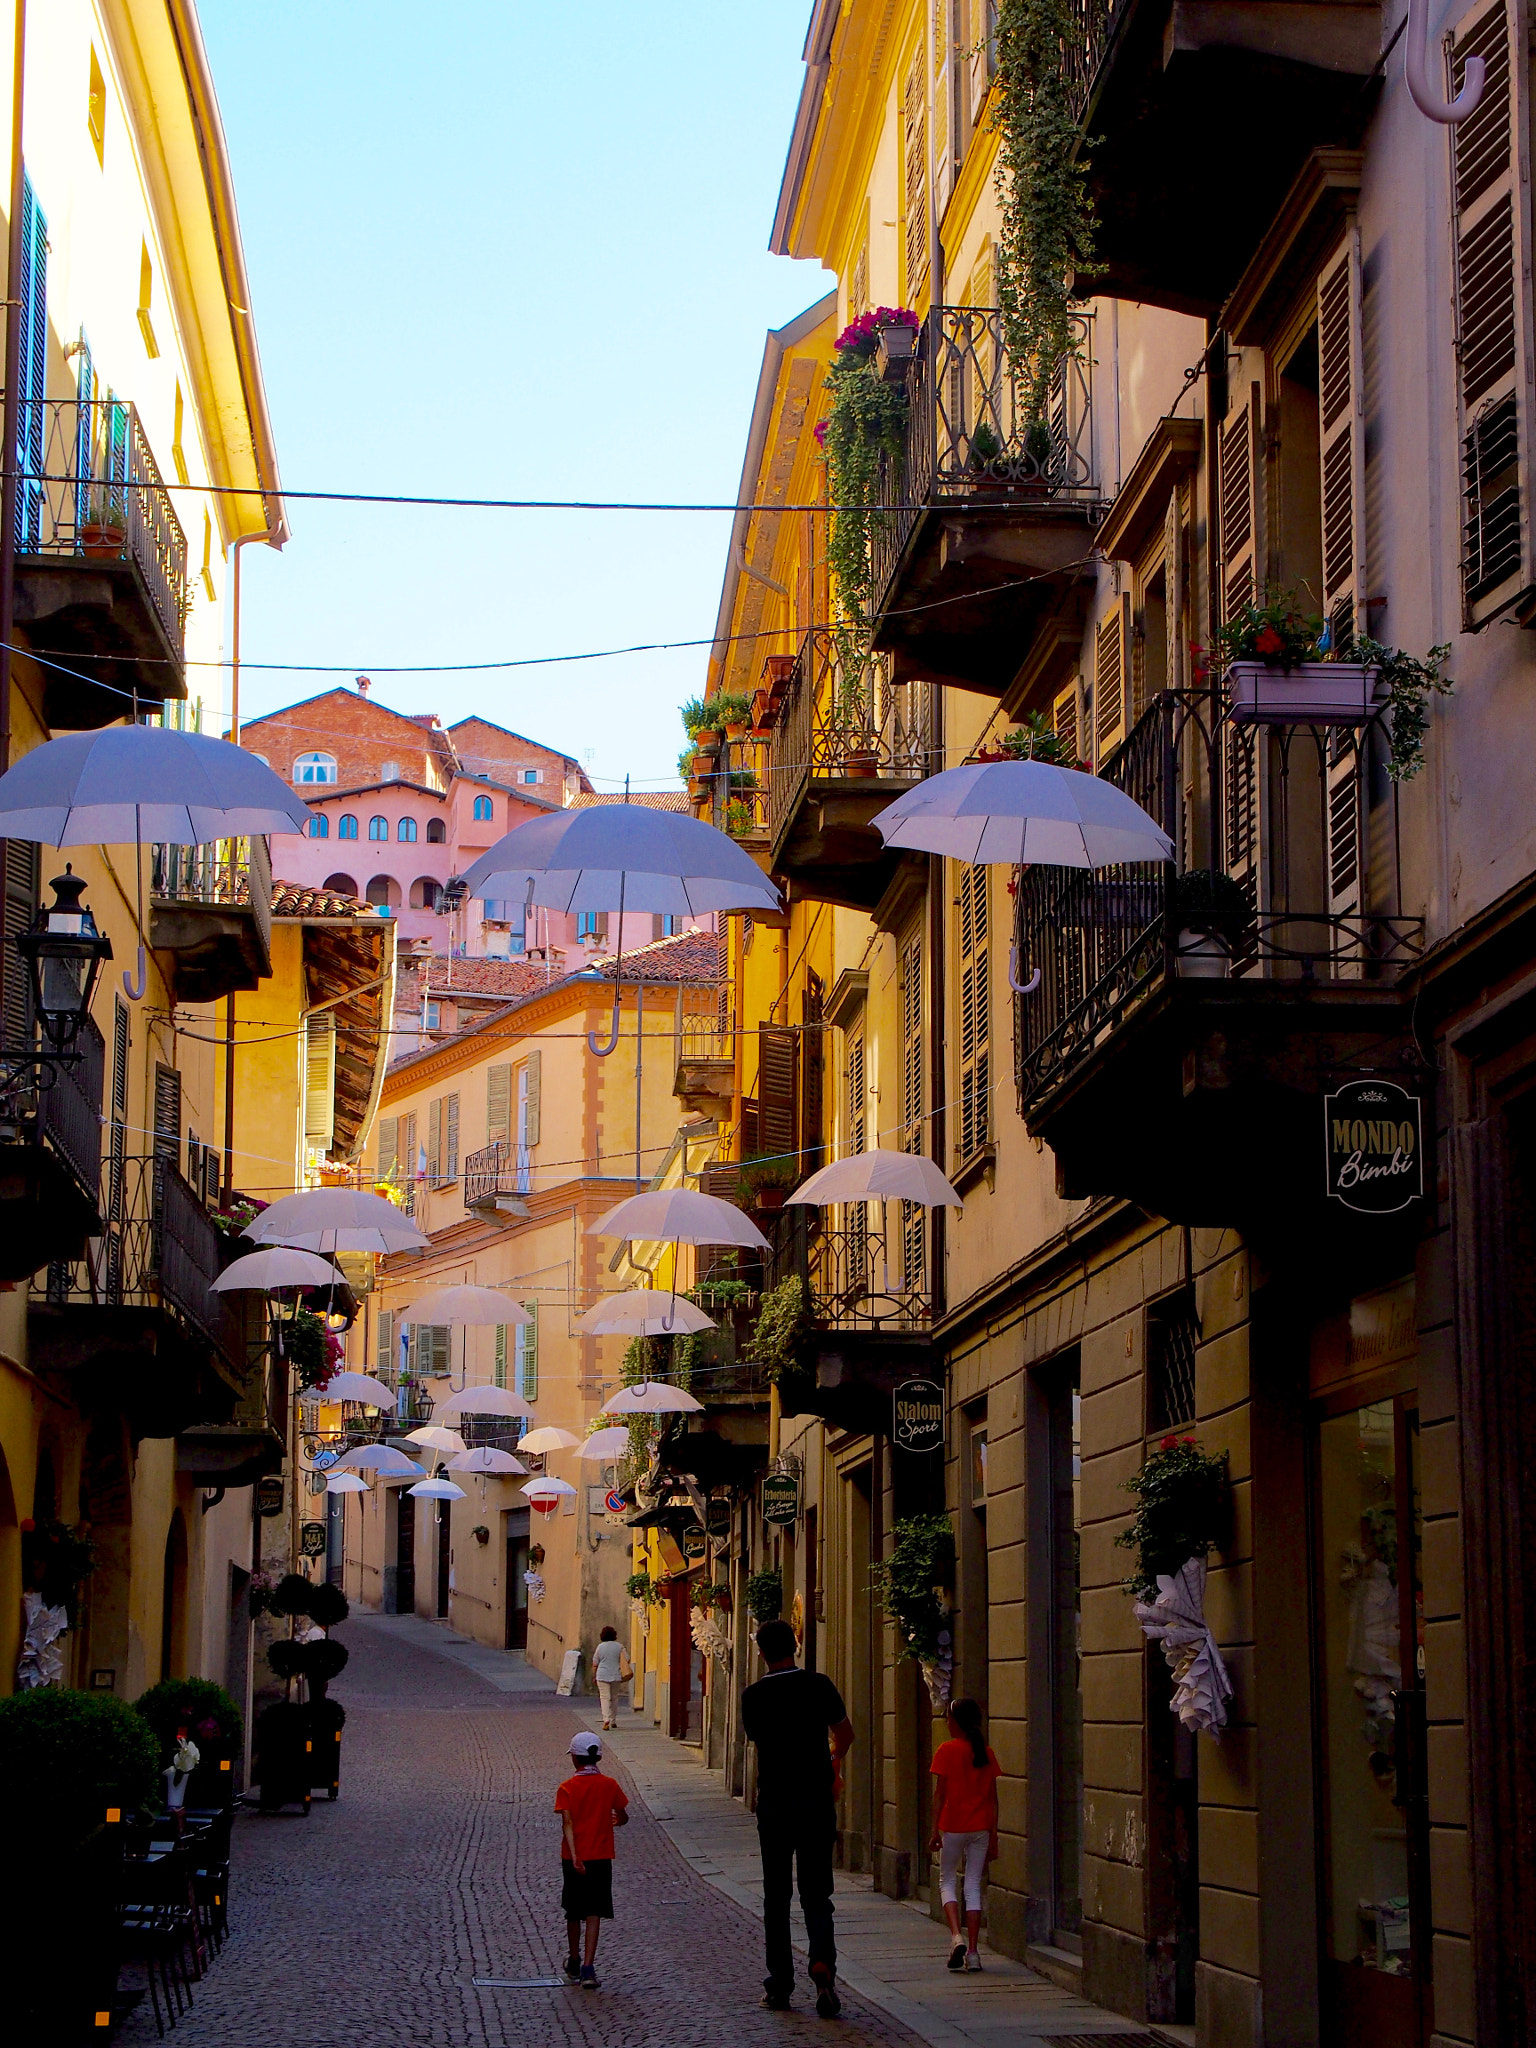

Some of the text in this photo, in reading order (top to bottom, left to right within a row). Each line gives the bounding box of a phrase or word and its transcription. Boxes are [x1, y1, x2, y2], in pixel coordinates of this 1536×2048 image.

[1332, 1119, 1415, 1155] MONDO
[1336, 1146, 1414, 1188] Bimbi
[897, 1401, 942, 1420] Slalom
[898, 1417, 940, 1442] Sport
[764, 1489, 797, 1501] Erboristeria
